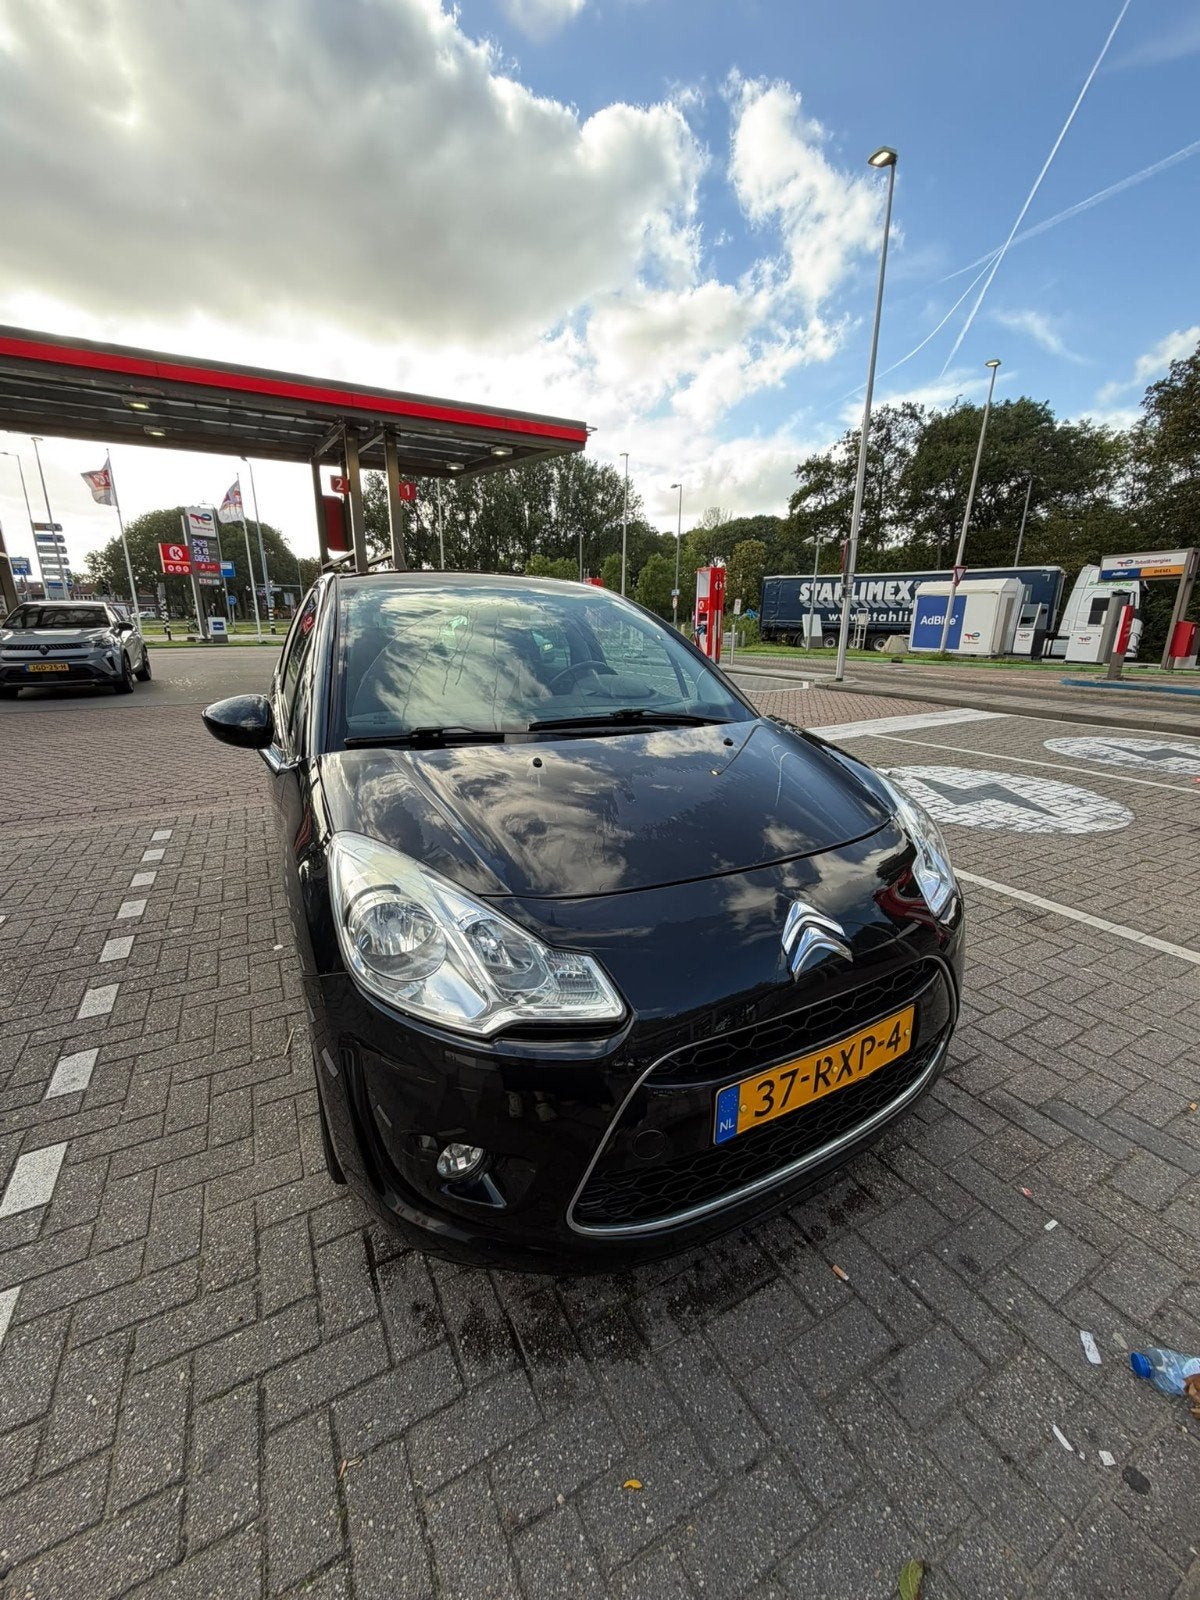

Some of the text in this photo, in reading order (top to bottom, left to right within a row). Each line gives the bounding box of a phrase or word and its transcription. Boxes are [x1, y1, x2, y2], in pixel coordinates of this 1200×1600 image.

[335, 478, 344, 491] 2
[404, 484, 410, 496] 1
[920, 615, 957, 625] AdBle
[754, 1020, 902, 1118] 37-RXP-4
[719, 1119, 735, 1133] NL
